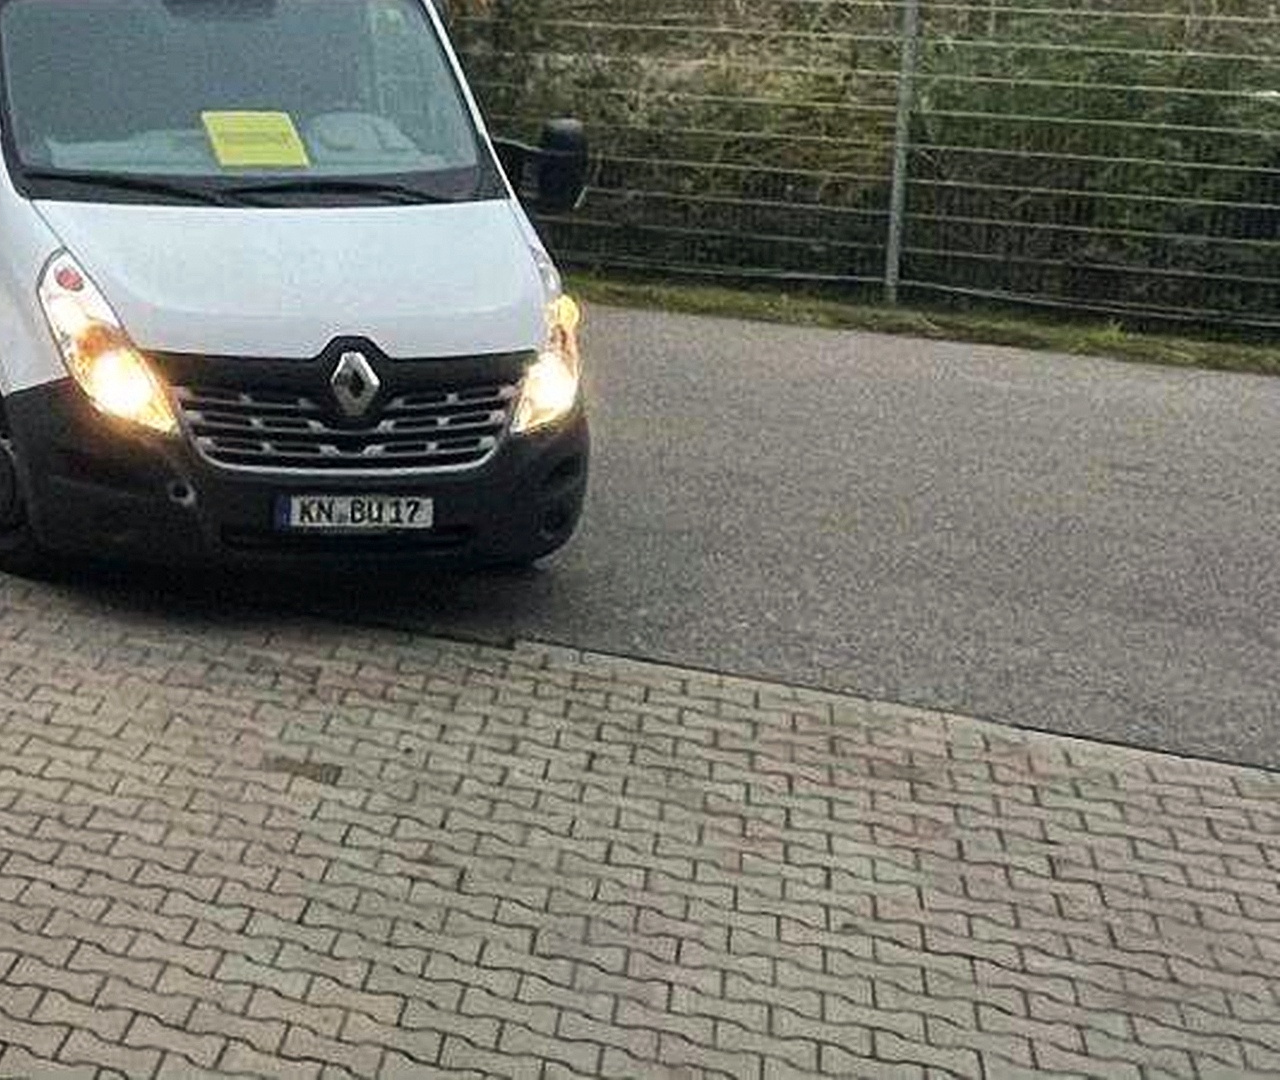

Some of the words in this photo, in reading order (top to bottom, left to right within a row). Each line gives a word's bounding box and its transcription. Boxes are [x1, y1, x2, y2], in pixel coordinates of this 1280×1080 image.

[299, 498, 335, 523] KN
[350, 499, 384, 524] BU
[389, 500, 422, 524] 17
